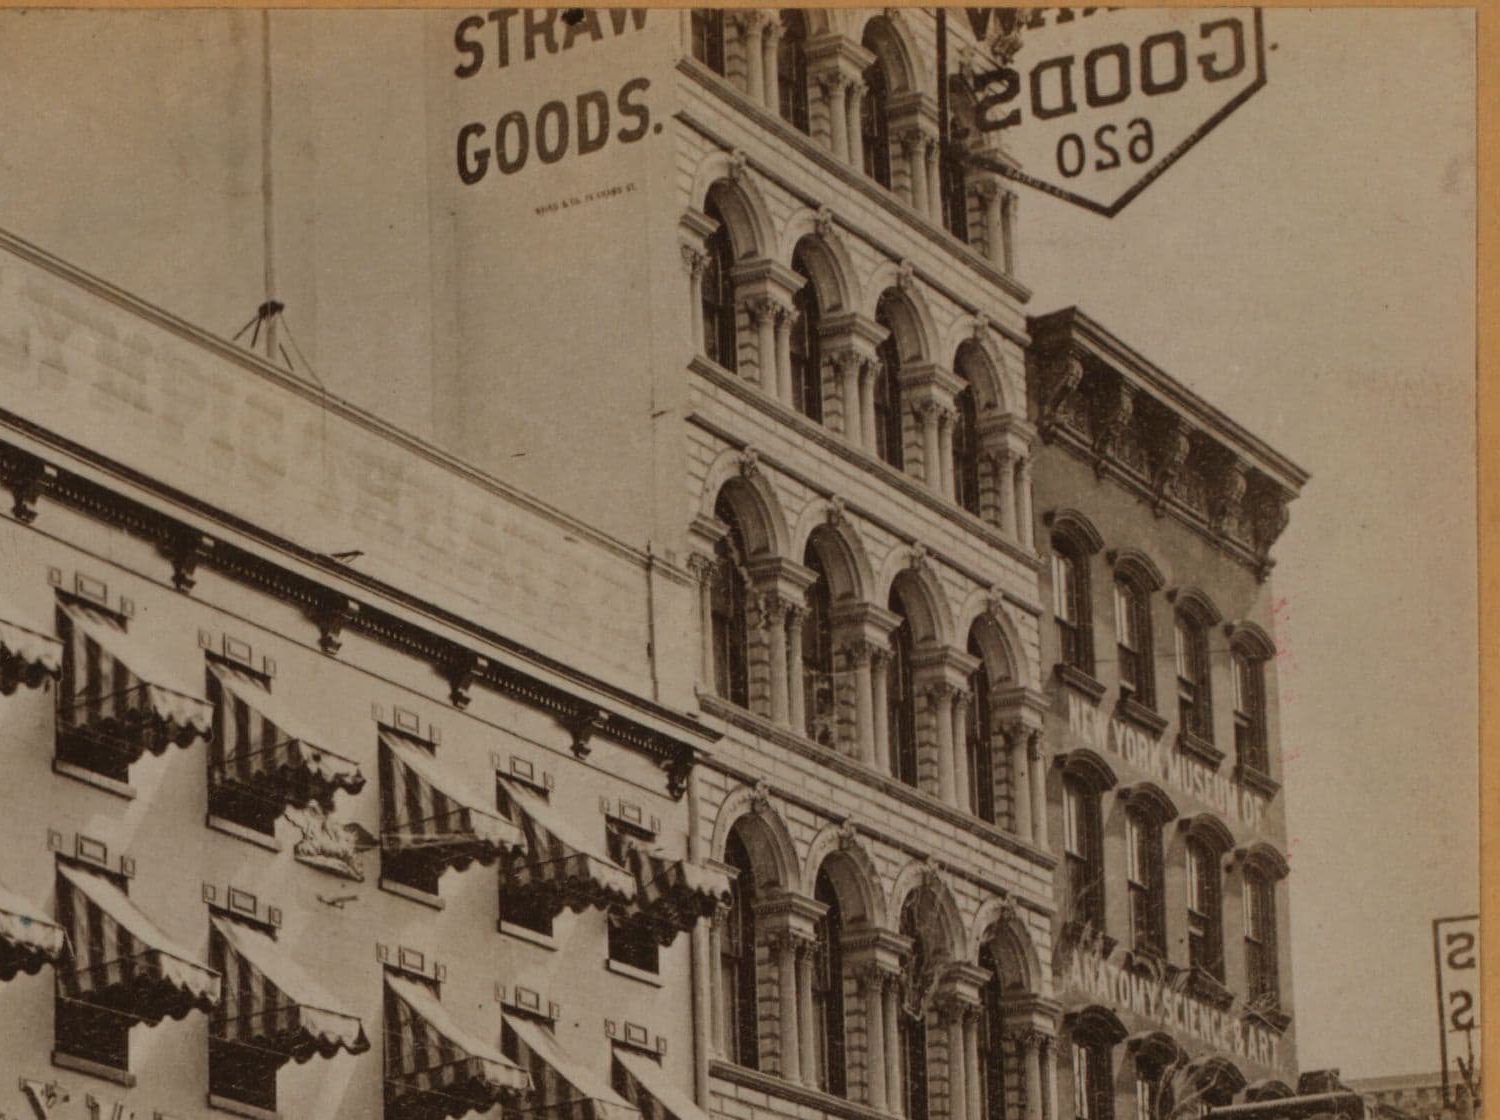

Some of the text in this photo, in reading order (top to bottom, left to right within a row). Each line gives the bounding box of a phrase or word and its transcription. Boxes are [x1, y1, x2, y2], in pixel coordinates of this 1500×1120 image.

[457, 77, 663, 185] GOODS.
[1068, 693, 1266, 834] NEW YORK MUSEUM OF
[1163, 987, 1232, 1053] SCIENCE
[1233, 1017, 1245, 1059] &
